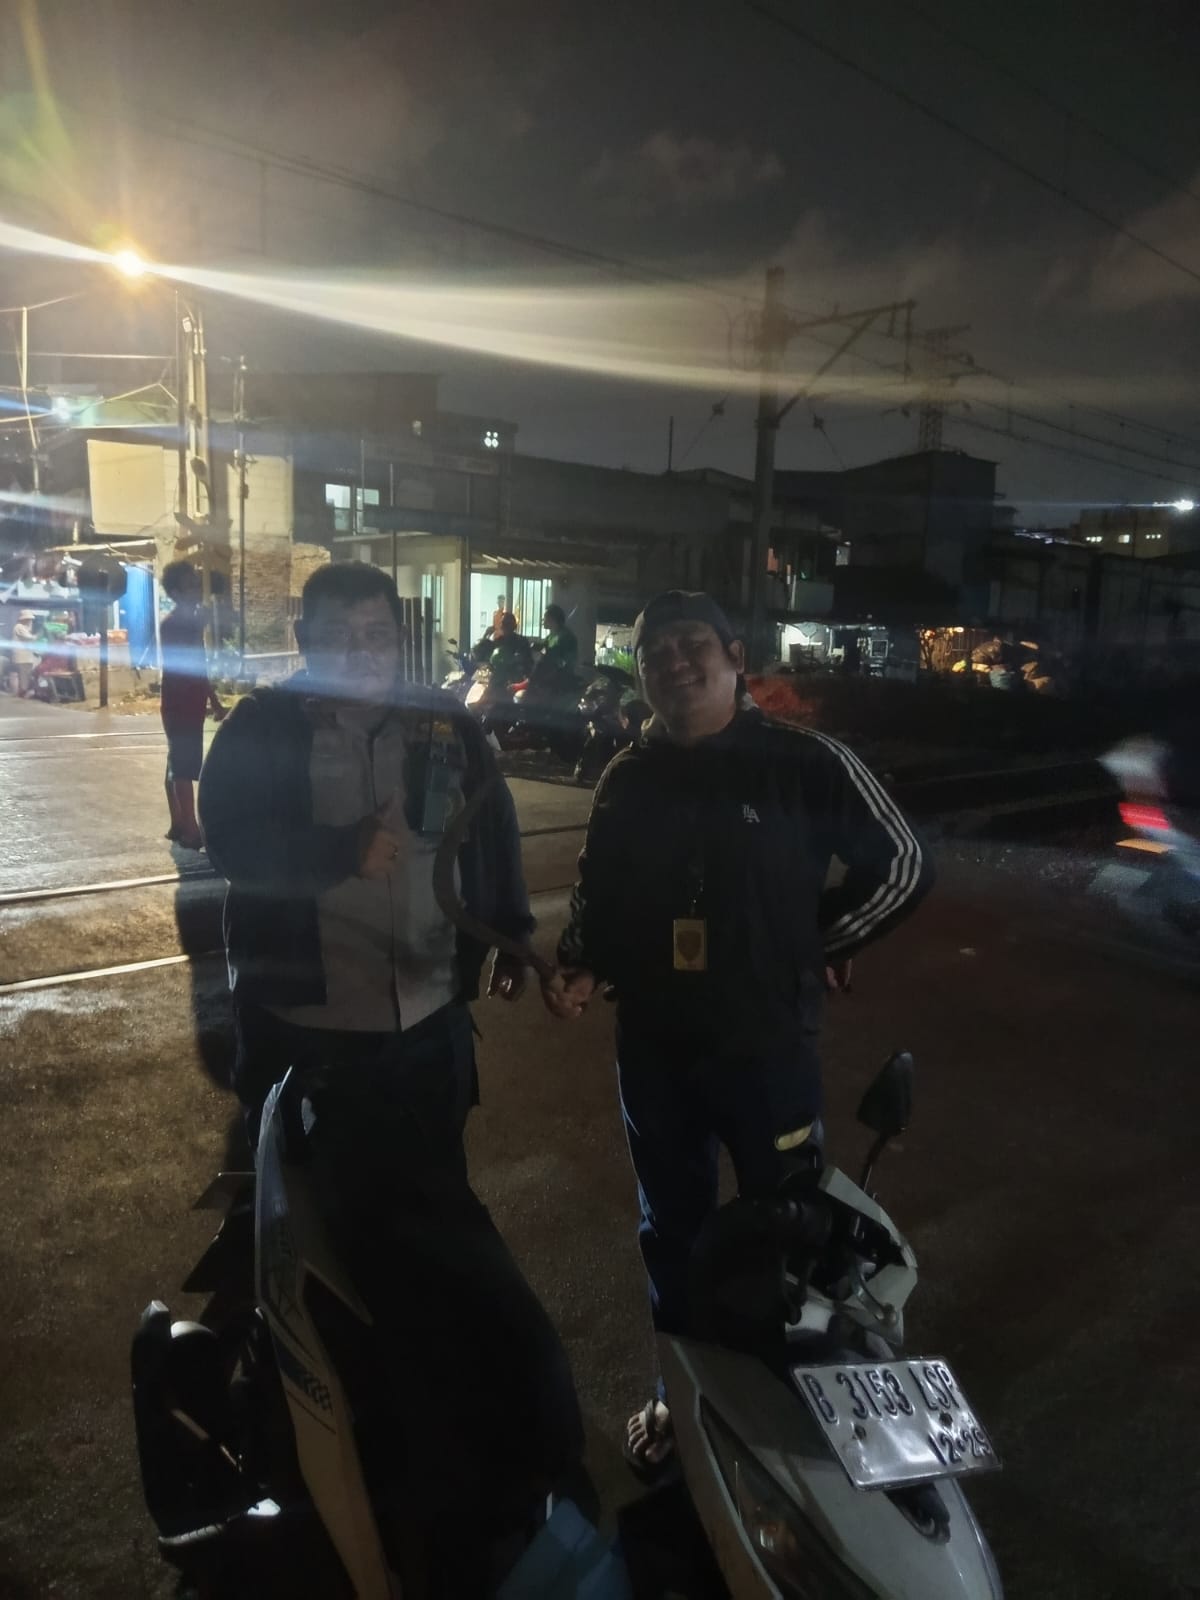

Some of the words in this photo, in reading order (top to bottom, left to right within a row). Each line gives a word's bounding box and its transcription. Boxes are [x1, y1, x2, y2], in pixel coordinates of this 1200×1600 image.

[803, 1373, 838, 1424] B
[836, 1369, 914, 1419] 3153
[908, 1365, 960, 1411] LSP
